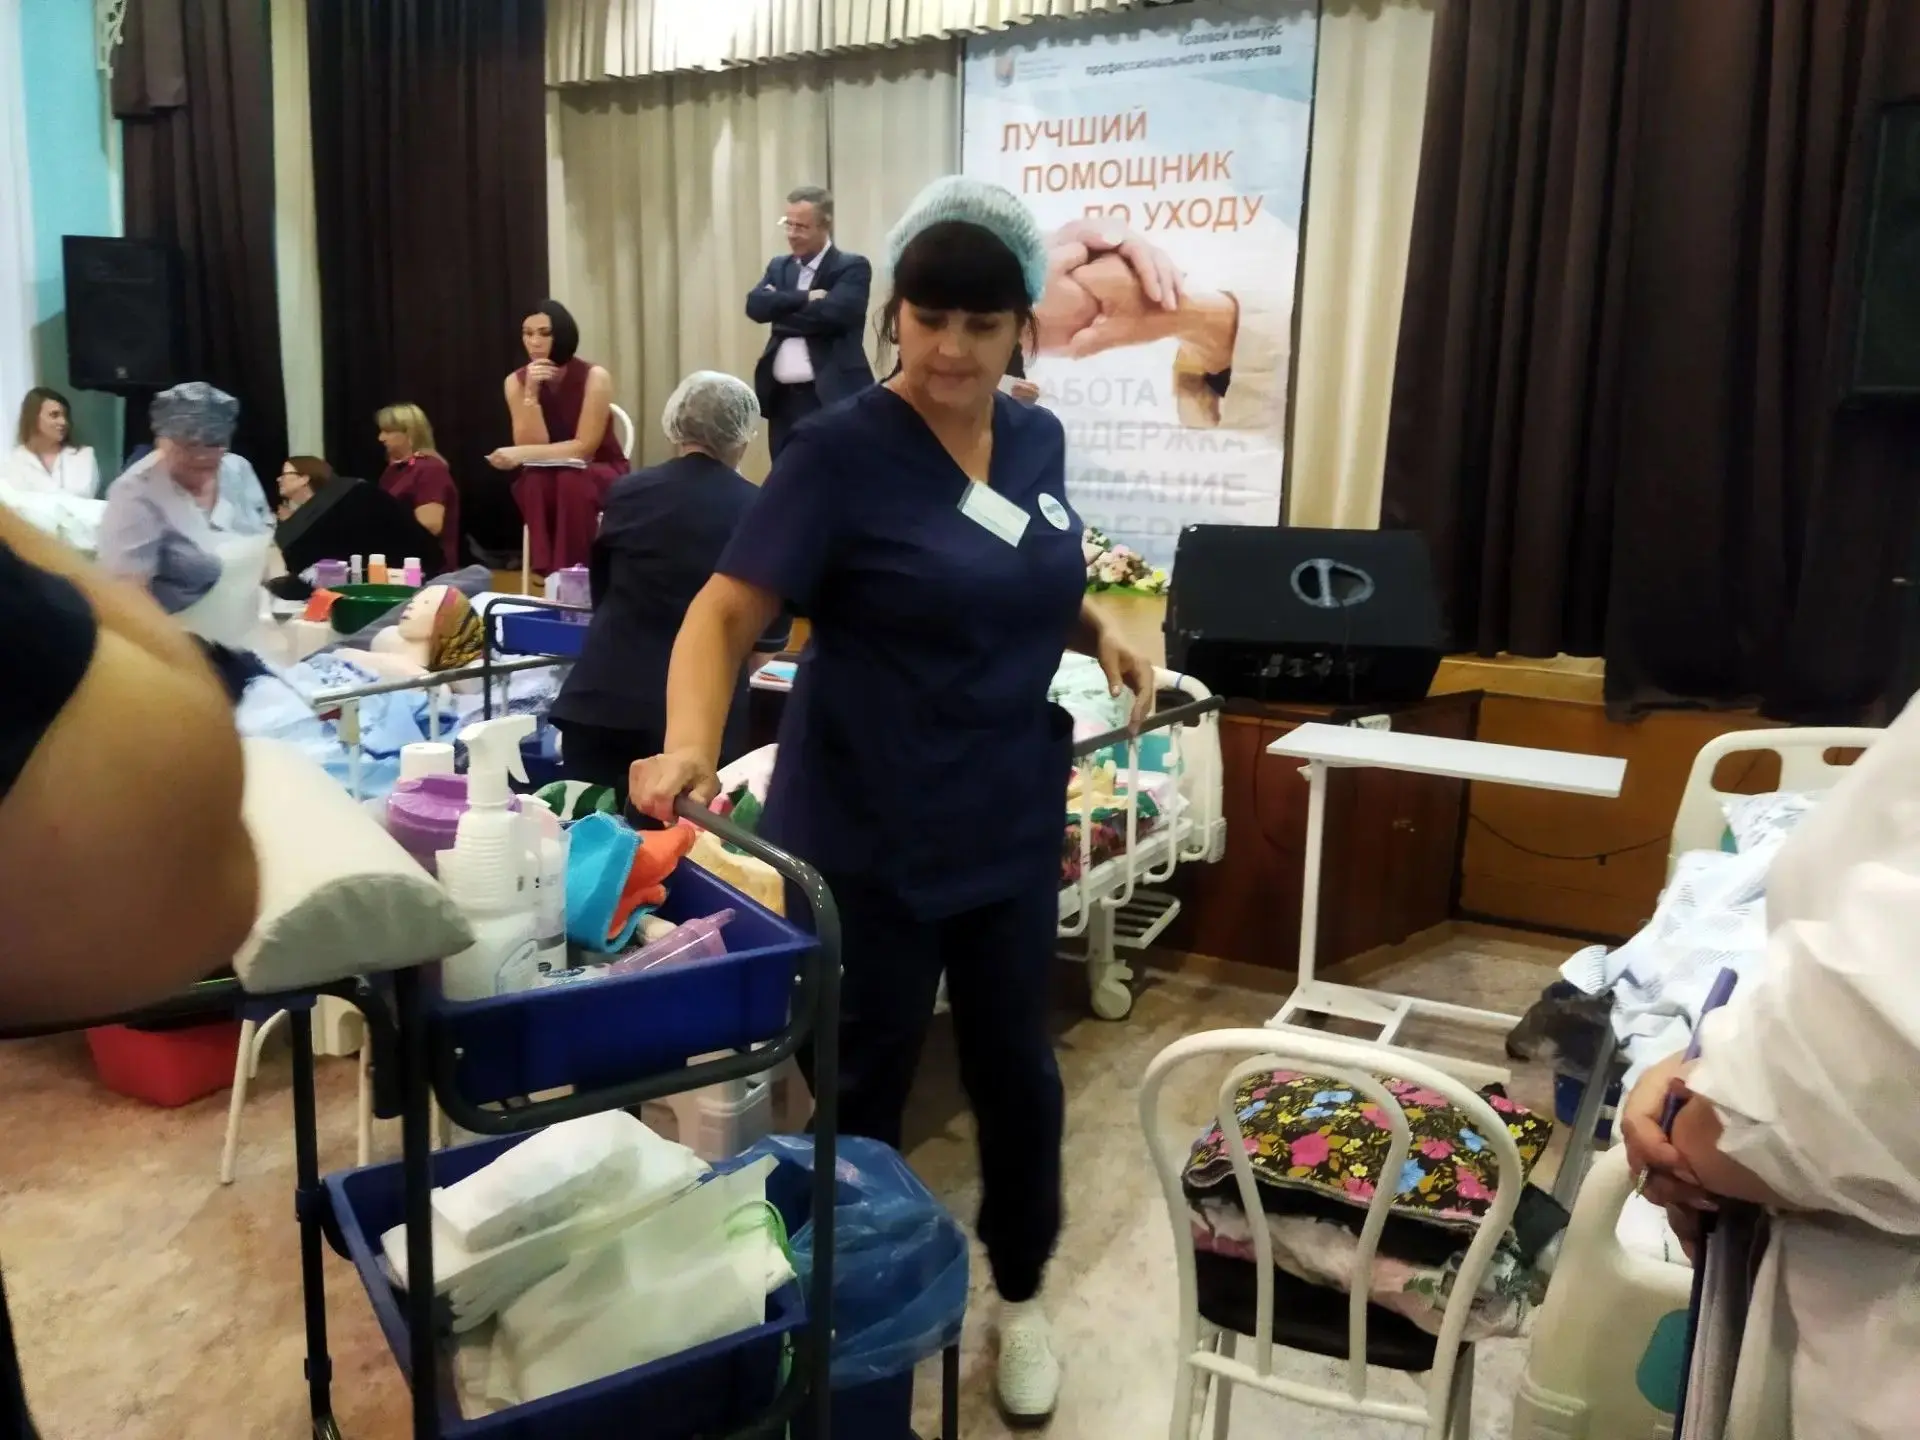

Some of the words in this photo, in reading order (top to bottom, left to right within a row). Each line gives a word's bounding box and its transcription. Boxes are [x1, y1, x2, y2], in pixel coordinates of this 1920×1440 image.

[1210, 45, 1282, 61] мастерства
[1001, 104, 1148, 152] ЛУЧШИЙ
[1023, 150, 1235, 194] ПОМОЩНИК
[1143, 195, 1264, 232] УХОДУ
[1040, 377, 1158, 407] АБОТА
[1066, 418, 1248, 454] ДДЕРЖКА
